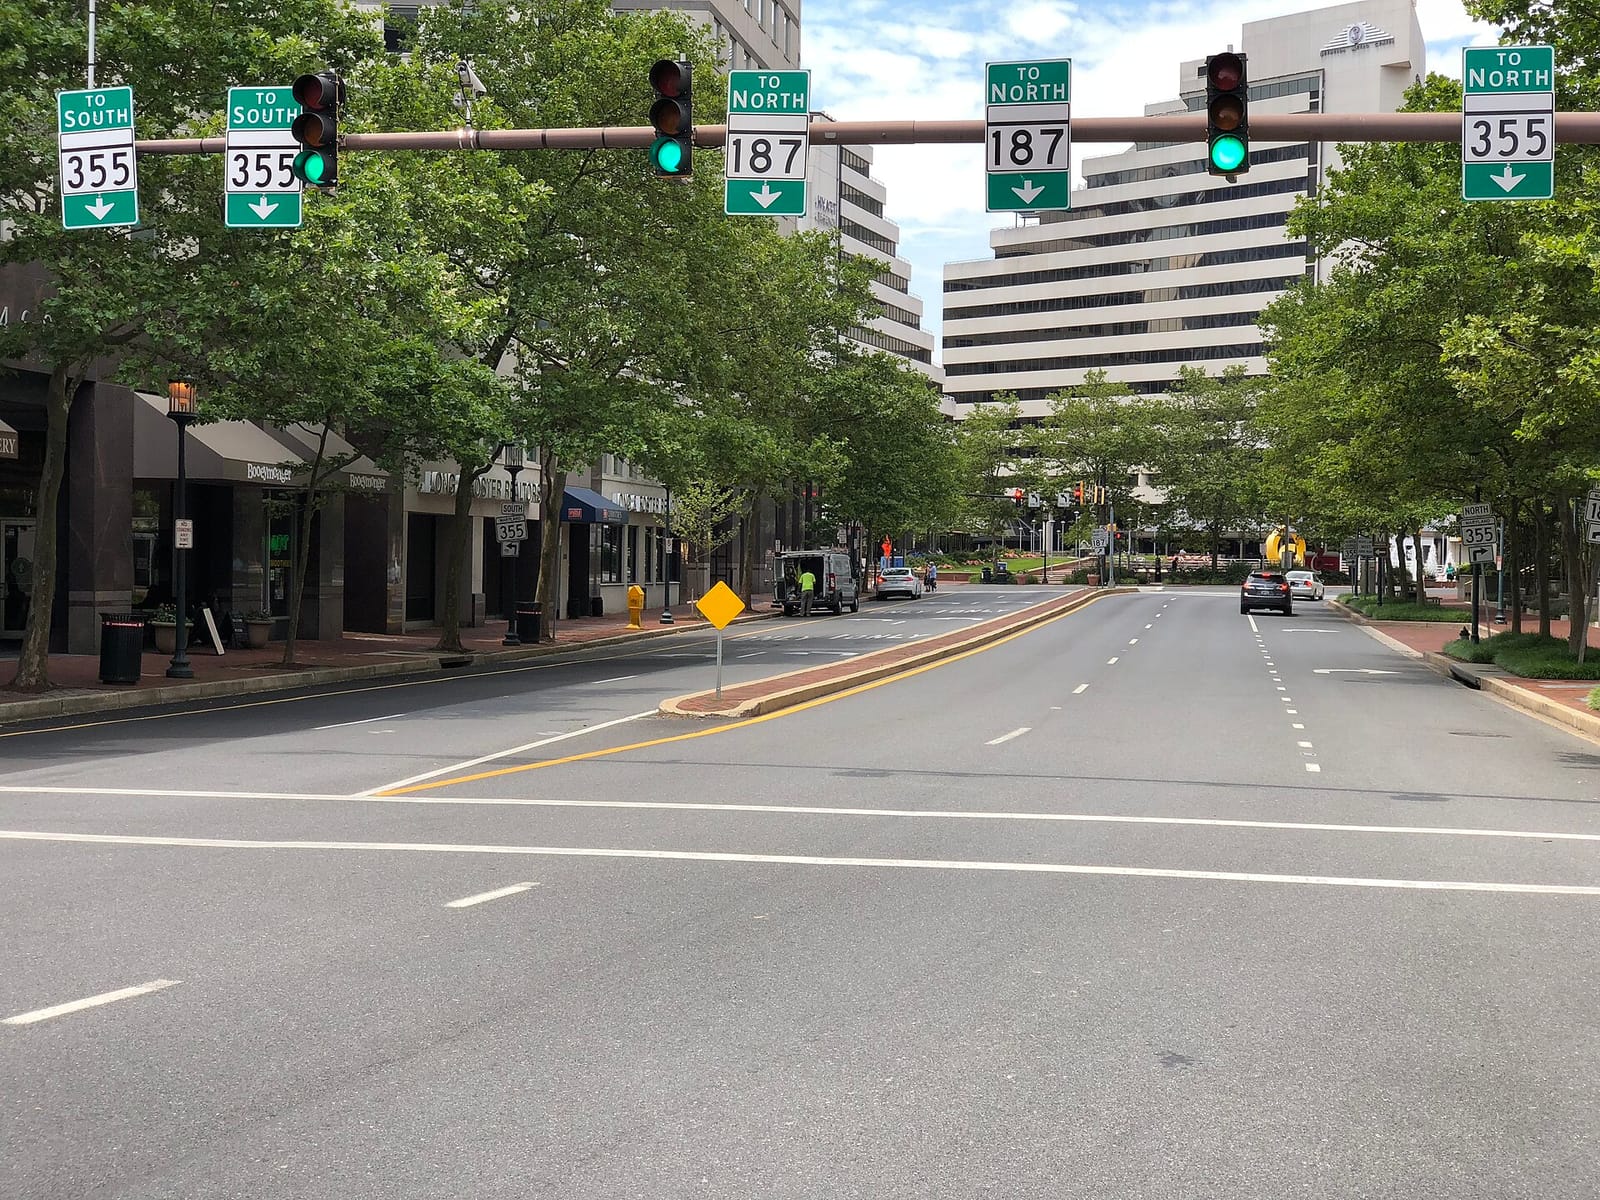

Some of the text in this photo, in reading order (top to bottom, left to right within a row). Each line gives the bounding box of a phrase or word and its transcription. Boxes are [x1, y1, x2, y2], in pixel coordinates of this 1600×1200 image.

[1497, 52, 1521, 66] TO
[758, 76, 780, 89] TO
[1017, 67, 1040, 81] TO
[1469, 68, 1549, 87] NORTH
[85, 94, 106, 107] TO
[255, 92, 276, 105] TO
[732, 90, 804, 109] NORTH
[991, 82, 1066, 102] NORTH
[64, 109, 129, 128] SOUTH
[233, 106, 298, 124] SOUTH
[991, 128, 1064, 166] 187
[1470, 119, 1546, 157] 355
[732, 138, 802, 174] 187
[67, 151, 130, 189] 355
[231, 153, 296, 188] 355
[472, 477, 502, 498] OSTER
[503, 504, 523, 513] SOUTH
[1464, 505, 1489, 516] NORTH
[500, 524, 524, 539] 355
[1465, 527, 1493, 543] 355
[1093, 539, 1105, 547] 187
